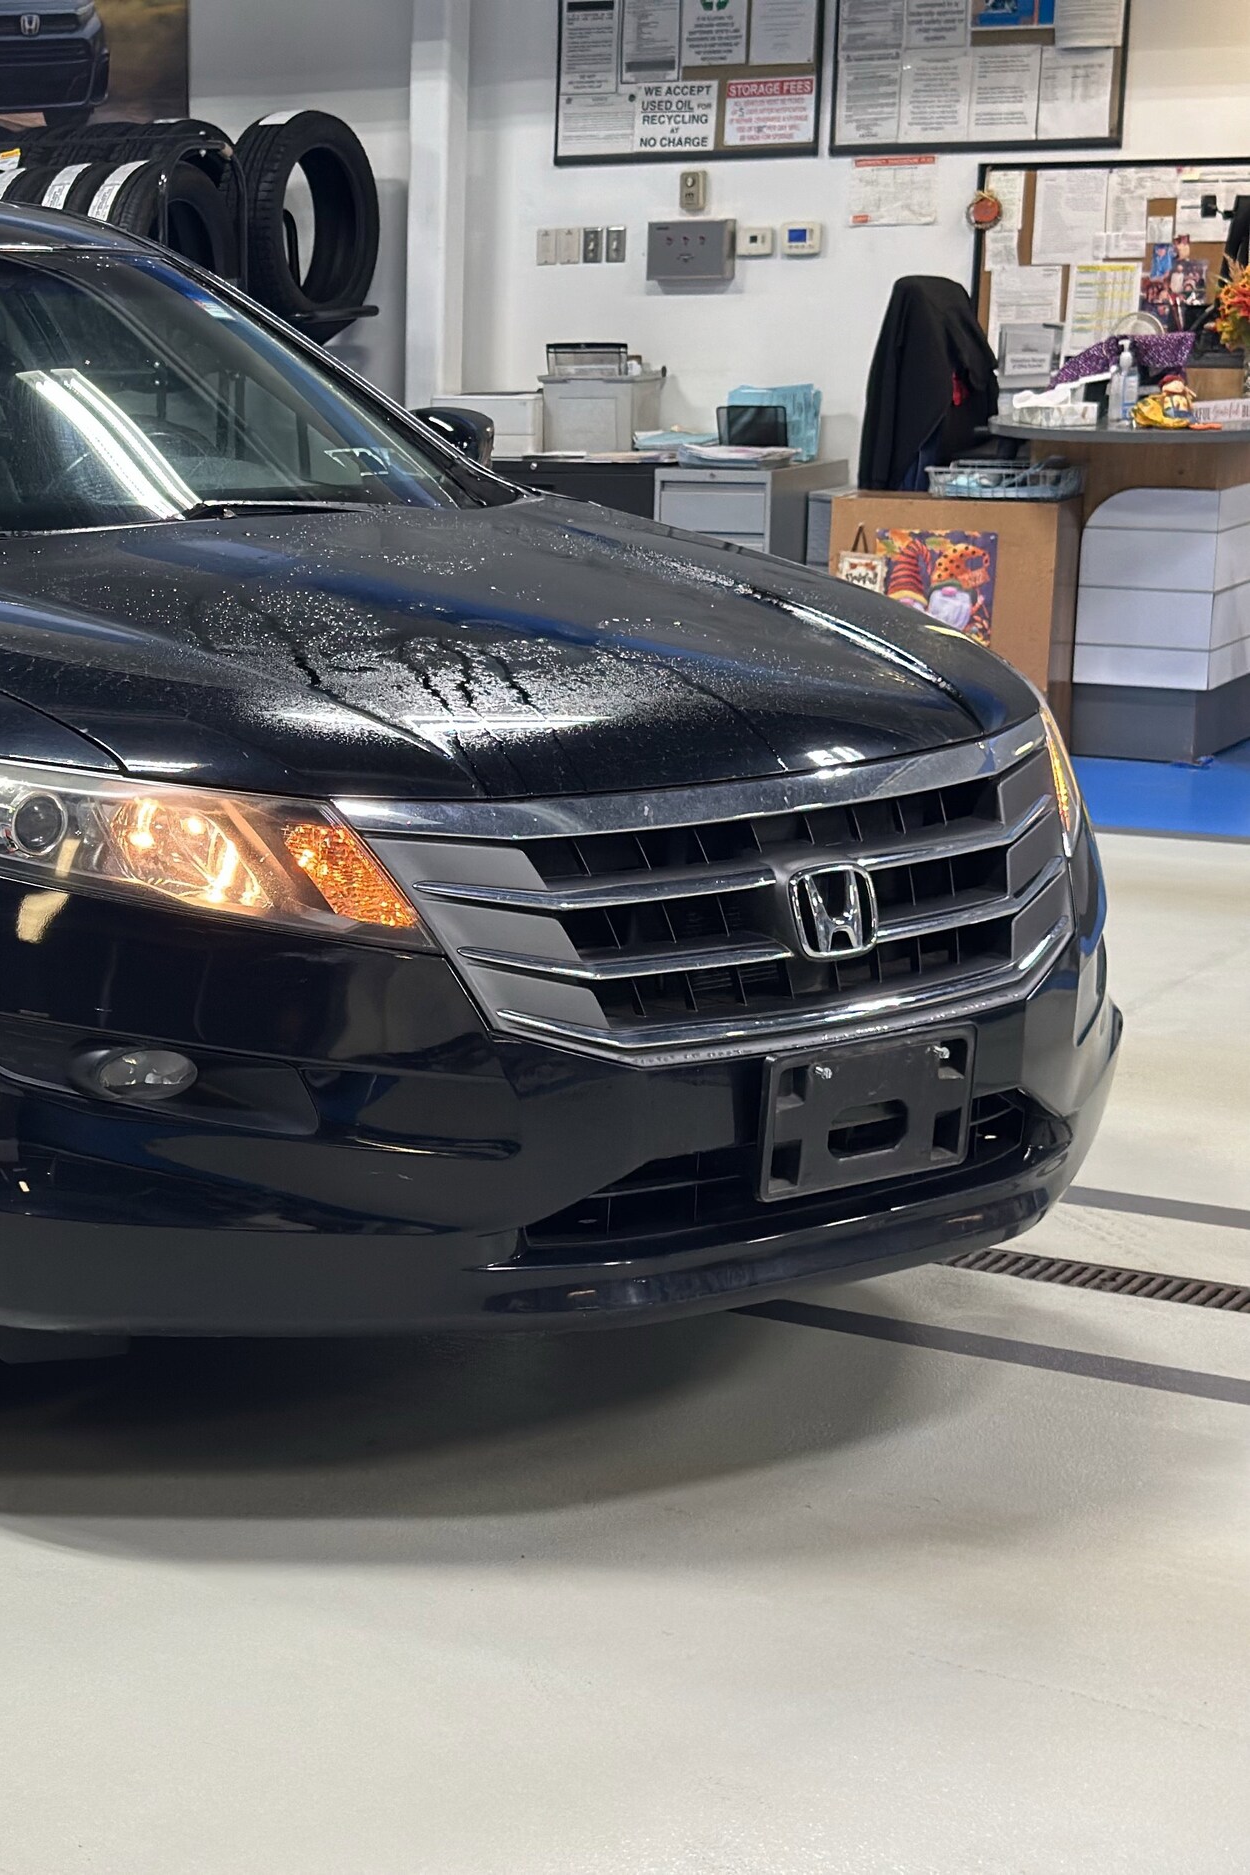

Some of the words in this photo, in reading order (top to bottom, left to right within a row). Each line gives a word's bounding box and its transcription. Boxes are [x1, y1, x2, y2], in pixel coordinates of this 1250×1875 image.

[644, 86, 662, 96] WE
[665, 85, 712, 96] ACCEPT
[728, 82, 780, 97] STORAGE
[782, 80, 811, 94] FEES
[641, 100, 673, 111] USED
[675, 100, 694, 111] OIL
[697, 102, 712, 110] FOR
[642, 114, 708, 125] RECYCLING
[639, 137, 657, 148] NO
[659, 136, 708, 148] CHARGE
